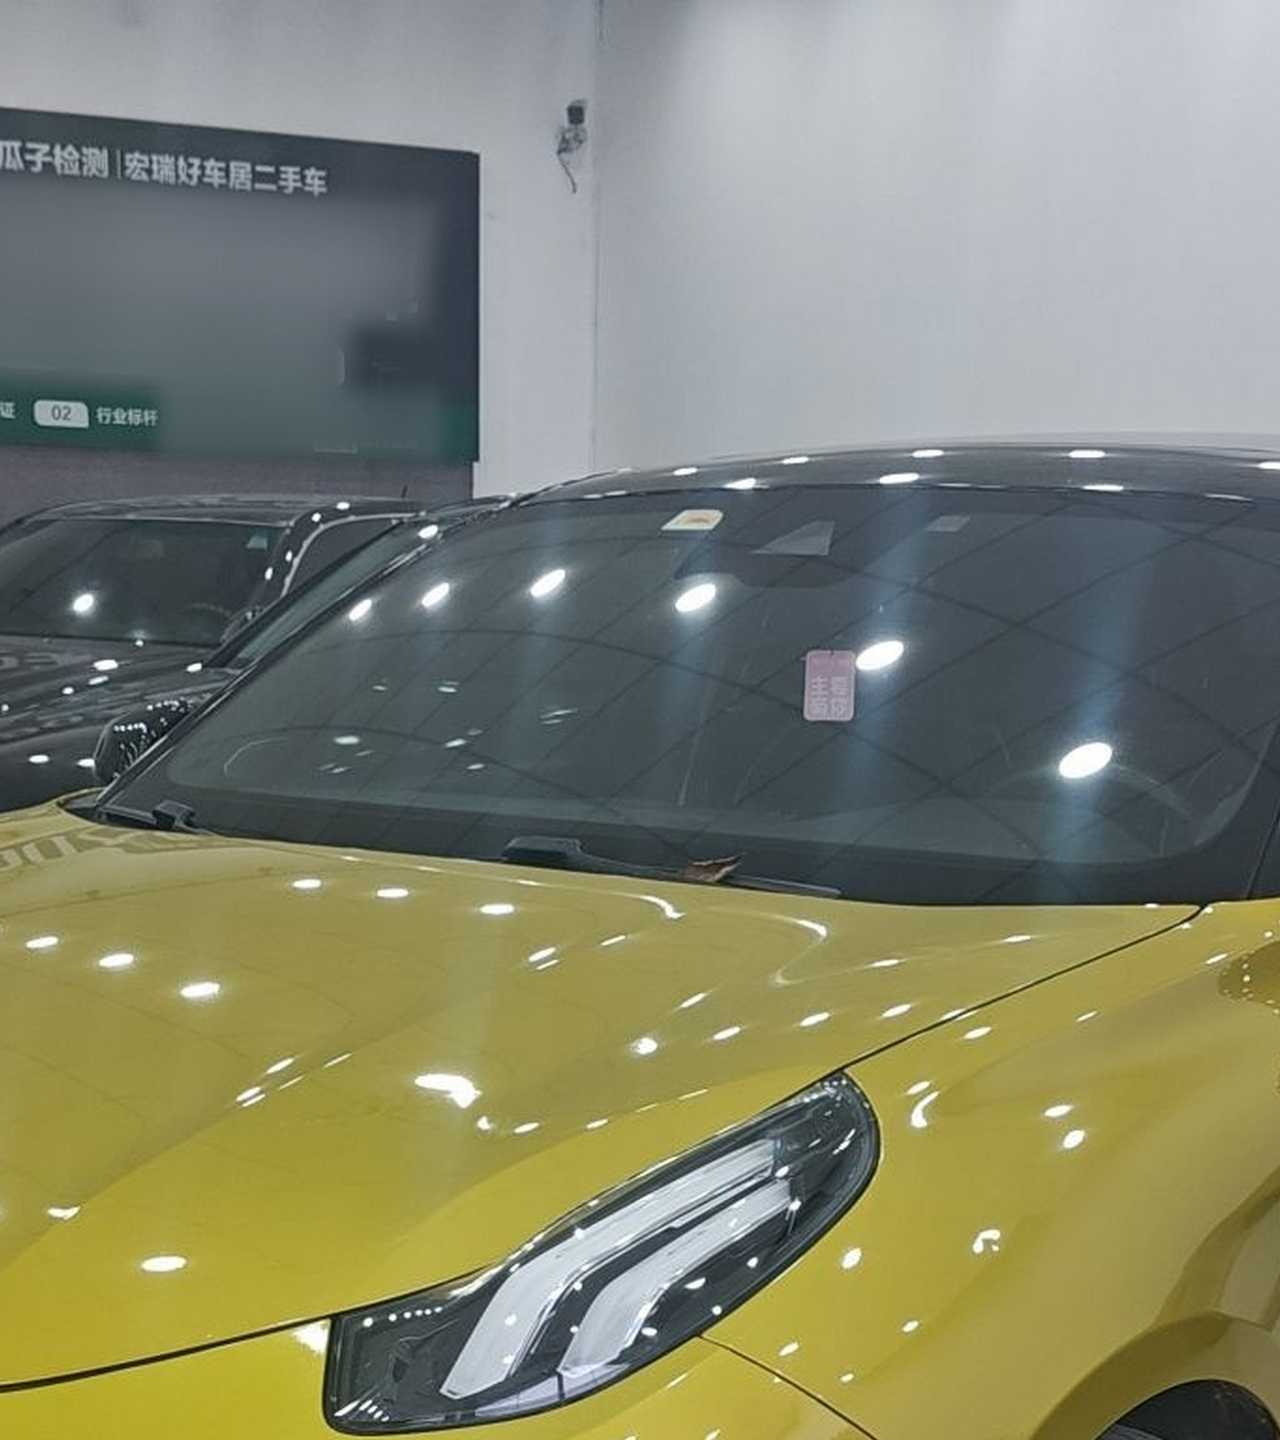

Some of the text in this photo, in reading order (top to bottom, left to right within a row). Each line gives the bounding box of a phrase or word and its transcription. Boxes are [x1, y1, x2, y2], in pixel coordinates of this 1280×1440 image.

[125, 151, 328, 197] 宏瑞好车居二手车
[50, 405, 158, 428] 02 行业标杆
